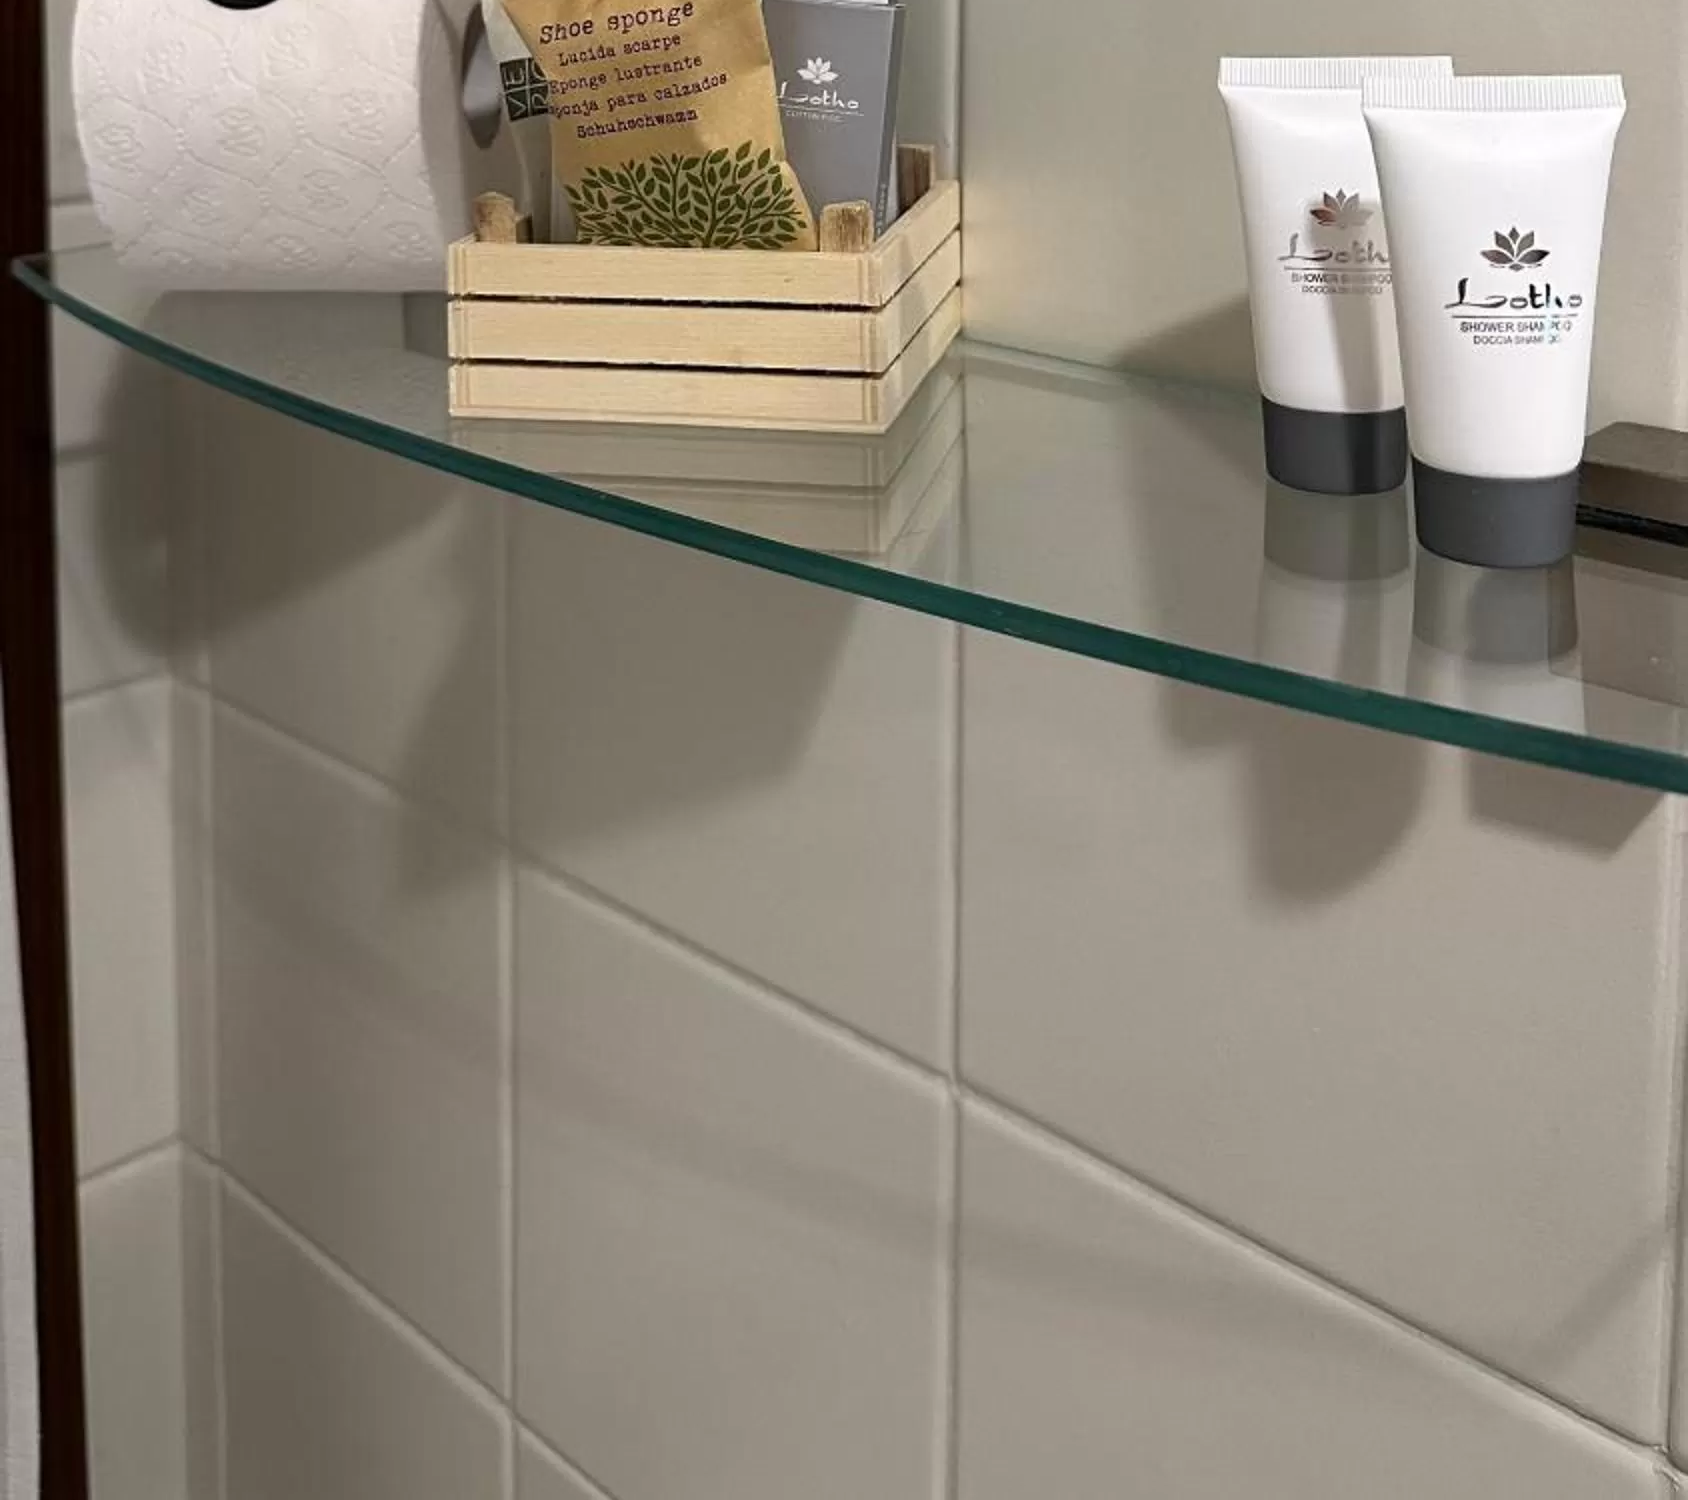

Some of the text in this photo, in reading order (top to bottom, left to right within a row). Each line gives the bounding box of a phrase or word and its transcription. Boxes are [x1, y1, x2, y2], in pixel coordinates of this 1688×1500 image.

[538, 1, 694, 45] Shoe sponge
[558, 33, 681, 67] Lucida scarpe
[613, 55, 703, 82] lustrante
[606, 91, 647, 112] para
[655, 72, 728, 101] calzados
[776, 81, 860, 109] Lotho
[577, 108, 699, 139] Schuhschwamm
[1277, 233, 1390, 263] Loth
[1444, 277, 1583, 309] Lotho
[1459, 321, 1514, 333] SHOWER
[1473, 334, 1512, 345] DOCCIA
